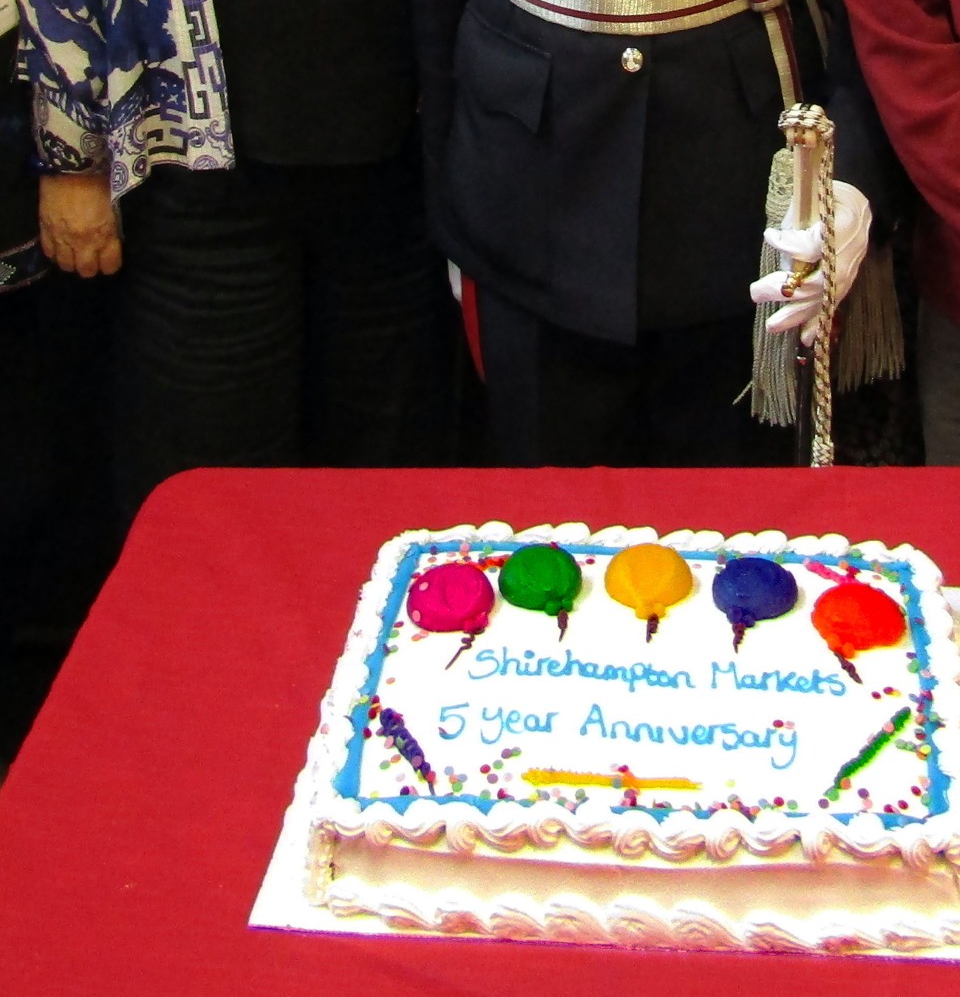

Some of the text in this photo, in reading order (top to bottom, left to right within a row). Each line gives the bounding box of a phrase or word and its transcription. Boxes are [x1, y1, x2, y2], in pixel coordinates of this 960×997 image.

[468, 646, 847, 697] Shirehampton Markets
[437, 701, 798, 770] 5 year Anniversary
